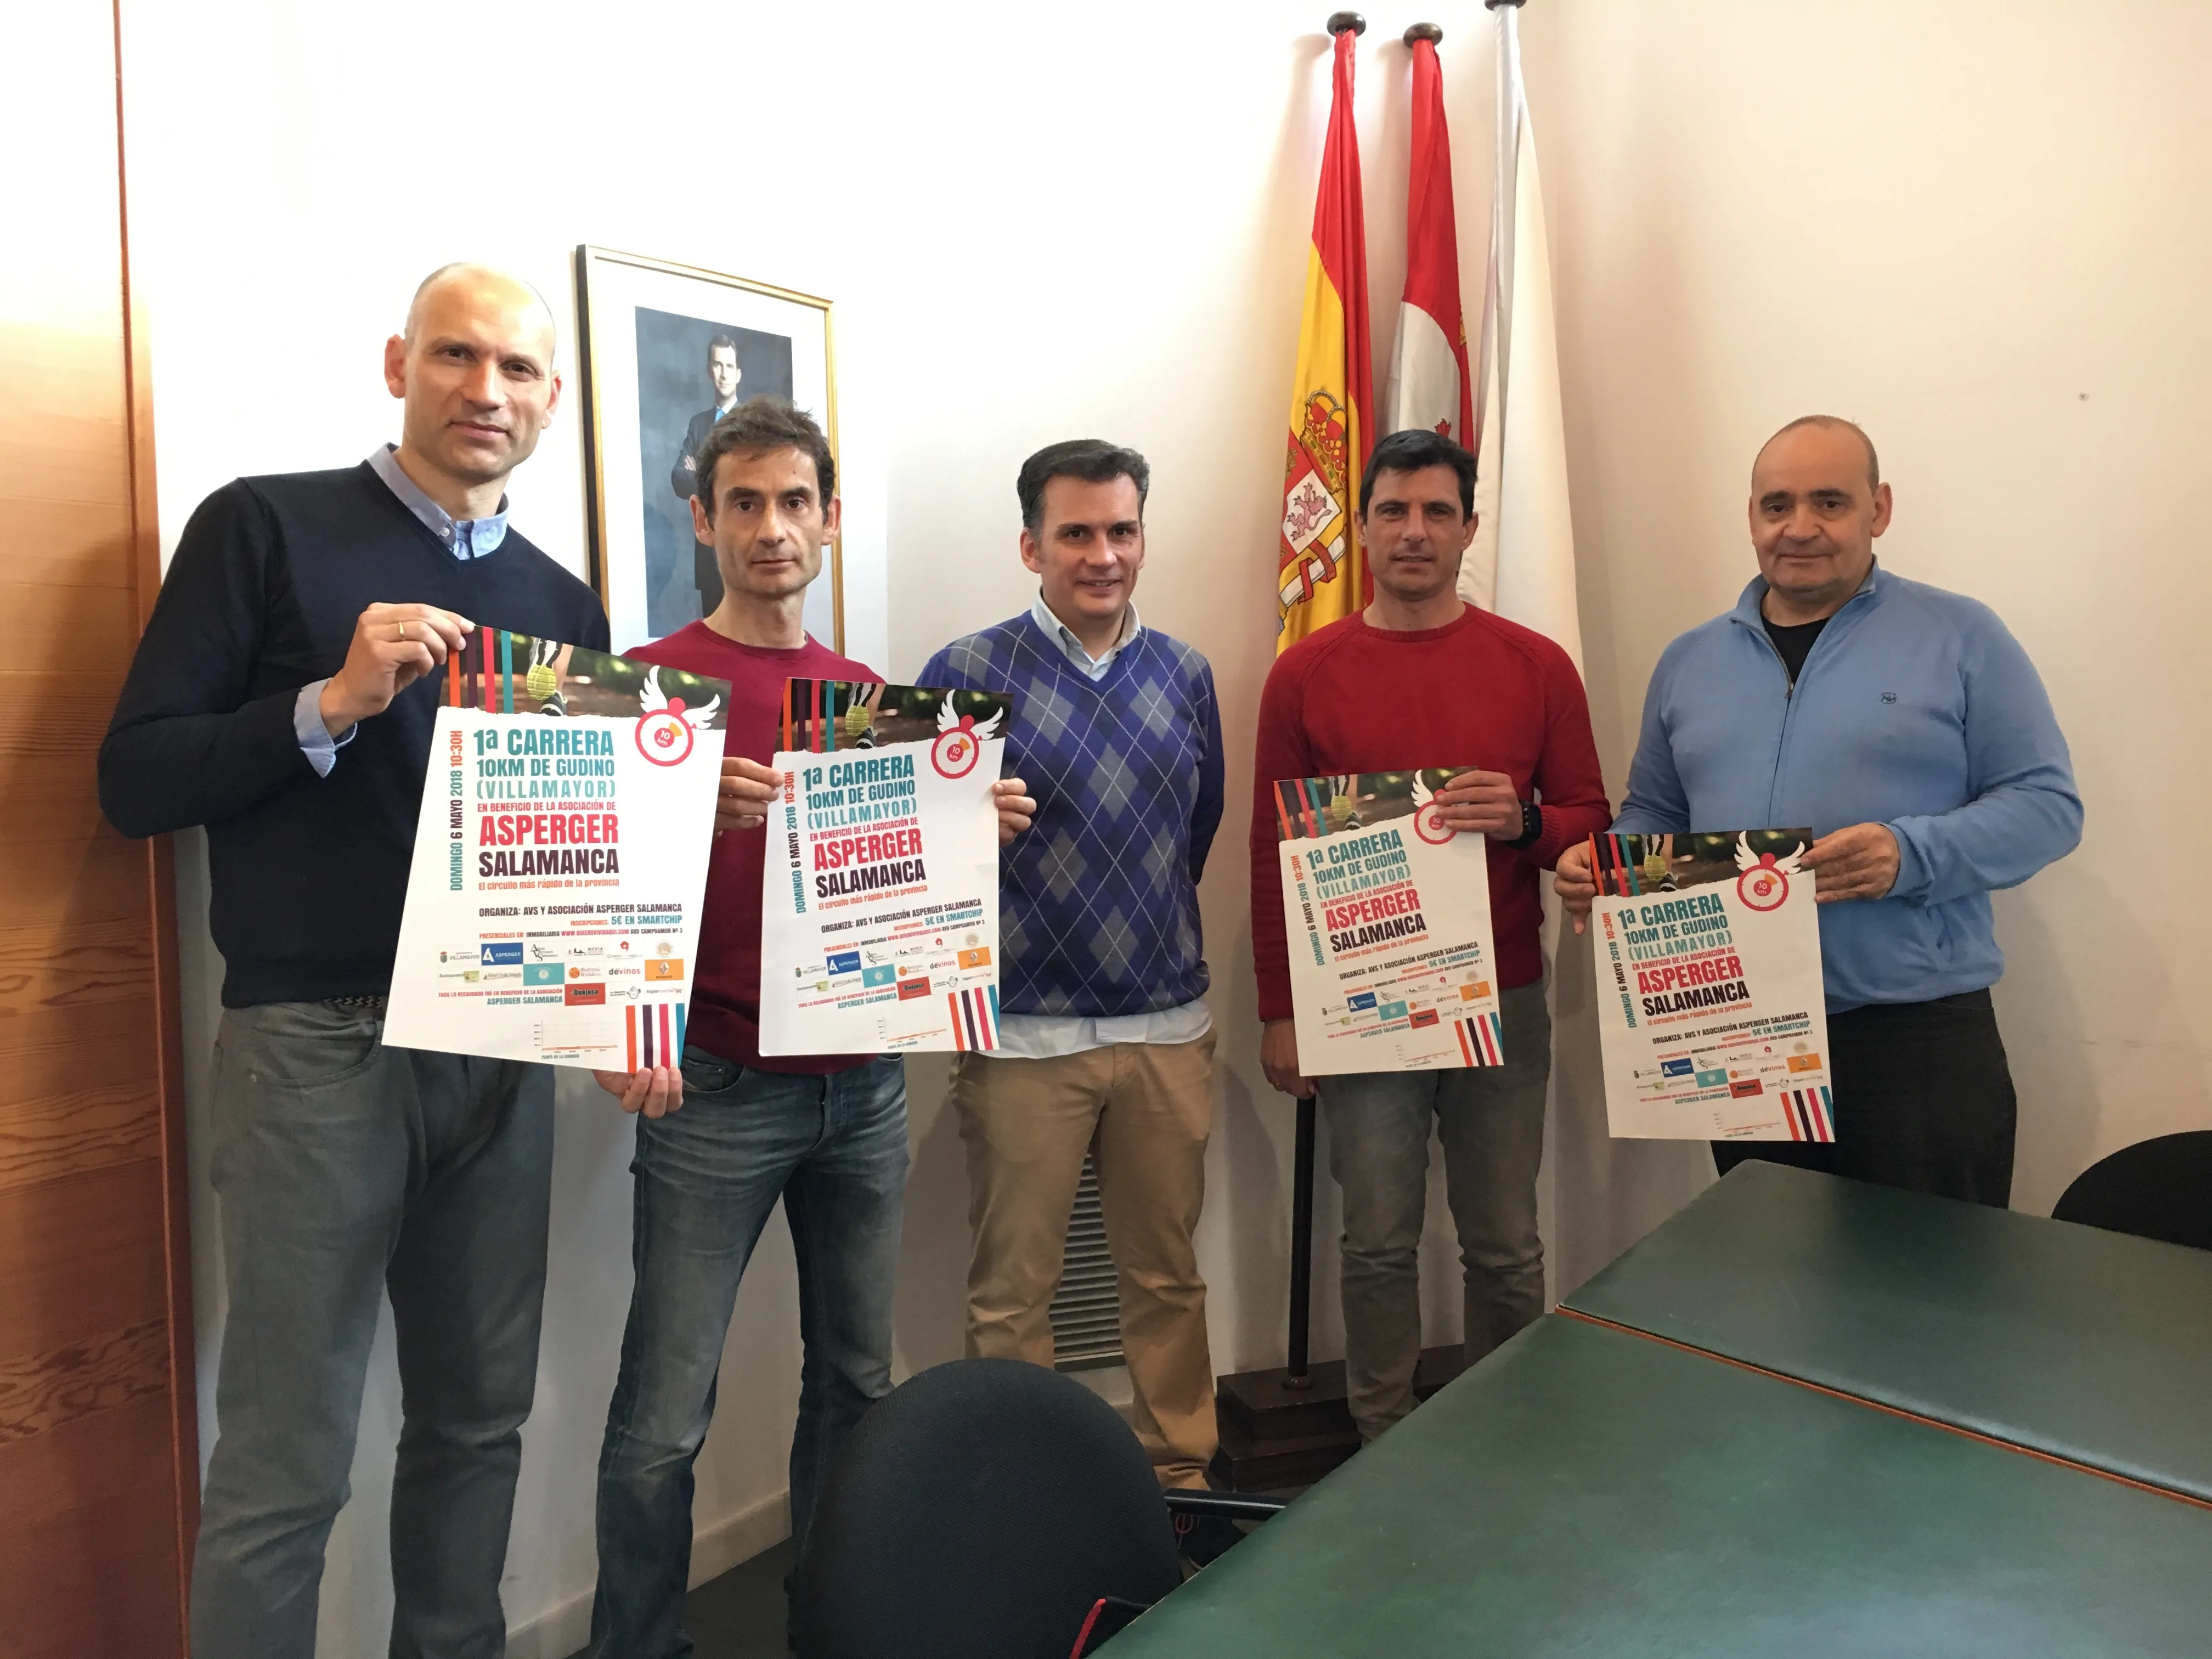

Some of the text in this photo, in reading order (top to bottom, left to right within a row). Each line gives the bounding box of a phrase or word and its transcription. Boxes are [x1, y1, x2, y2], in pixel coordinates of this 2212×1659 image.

[507, 729, 614, 755] CARRERA
[661, 730, 670, 740] 10
[450, 731, 462, 767] 10:30H
[477, 759, 524, 777] 10KM
[531, 759, 550, 776] DE
[830, 754, 914, 788] CARRERA
[450, 770, 462, 796] 2018
[477, 780, 615, 799] (VILLAMAYOR)
[783, 771, 795, 804] 10:30H
[478, 799, 616, 812] EN BENEFICIO DE LA ASOCIACIÓN DE
[806, 789, 844, 810] 10KM
[848, 787, 865, 804] DE
[450, 800, 462, 828] MAYO
[786, 806, 797, 830] 2018
[808, 798, 916, 830] (VILLAMAYOR)
[479, 814, 618, 846] ASPERGER
[810, 817, 918, 842] EN BENEFICIO DE LA ASOCIACIÓN DE
[788, 832, 800, 859] MAYO
[814, 828, 923, 871] ASPERGER
[1328, 829, 1403, 864] CARRERA
[450, 843, 462, 890] DOMINGO
[479, 849, 619, 877] SALAMANCA
[1291, 855, 1304, 882] 10:30H
[1313, 865, 1346, 884] 10KM
[1347, 860, 1363, 876] DE
[487, 881, 517, 890] circuito
[520, 879, 535, 889] más
[538, 879, 562, 889] rápido
[585, 878, 619, 888] provincia
[792, 870, 806, 913] DOMINGO
[815, 858, 927, 898] SALAMANCA
[1298, 882, 1309, 901] 2018
[479, 903, 682, 917] ORGANIZA: AVS Y ASOCIACIÓN ASPERGER SALAMANCA
[825, 899, 849, 909] circuito
[850, 895, 863, 905] más
[864, 892, 884, 902] rápido
[900, 885, 928, 896] provincia
[1325, 888, 1420, 932] ASPERGER
[1640, 893, 1724, 926] CARRERA
[611, 916, 622, 925] 5€
[625, 916, 634, 924] EN
[637, 915, 682, 924] SMARTCHIP
[821, 921, 854, 933] ORGANIZA:
[856, 918, 867, 927] AVS
[874, 909, 911, 924] ASOCIACIÓN
[912, 905, 943, 917] ASPERGER
[944, 899, 981, 912] SALAMANCA
[925, 909, 983, 926] 5€ EN SMARTCHIP
[1303, 902, 1314, 923] MAYO
[1602, 912, 1615, 940] 10:30H
[1330, 913, 1426, 952] SALAMANCA
[1624, 927, 1660, 945] 10KM
[1661, 924, 1679, 939] DE
[1310, 932, 1325, 966] DOMINGO
[1339, 968, 1367, 980] ORGANIZA:
[1368, 965, 1379, 973] AVS
[1384, 955, 1416, 969] ASOCIACIÓN
[1417, 949, 1444, 961] ASPERGER
[1444, 941, 1478, 955] SALAMANCA
[1609, 941, 1620, 961] 2018
[930, 960, 956, 969] devinos
[1614, 963, 1626, 984] MAYO
[1638, 955, 1743, 995] ASPERGER
[838, 992, 897, 1009] ASPERGER SALAMANCA
[1621, 994, 1637, 1028] DOMINGO
[1643, 980, 1750, 1016] SALAMANCA
[1652, 1034, 1683, 1044] ORGANIZA:
[1702, 1023, 1738, 1036] ASOCIACIÓN
[1739, 1018, 1769, 1029] ASPERGER
[1770, 1012, 1808, 1024] SALAMANCA
